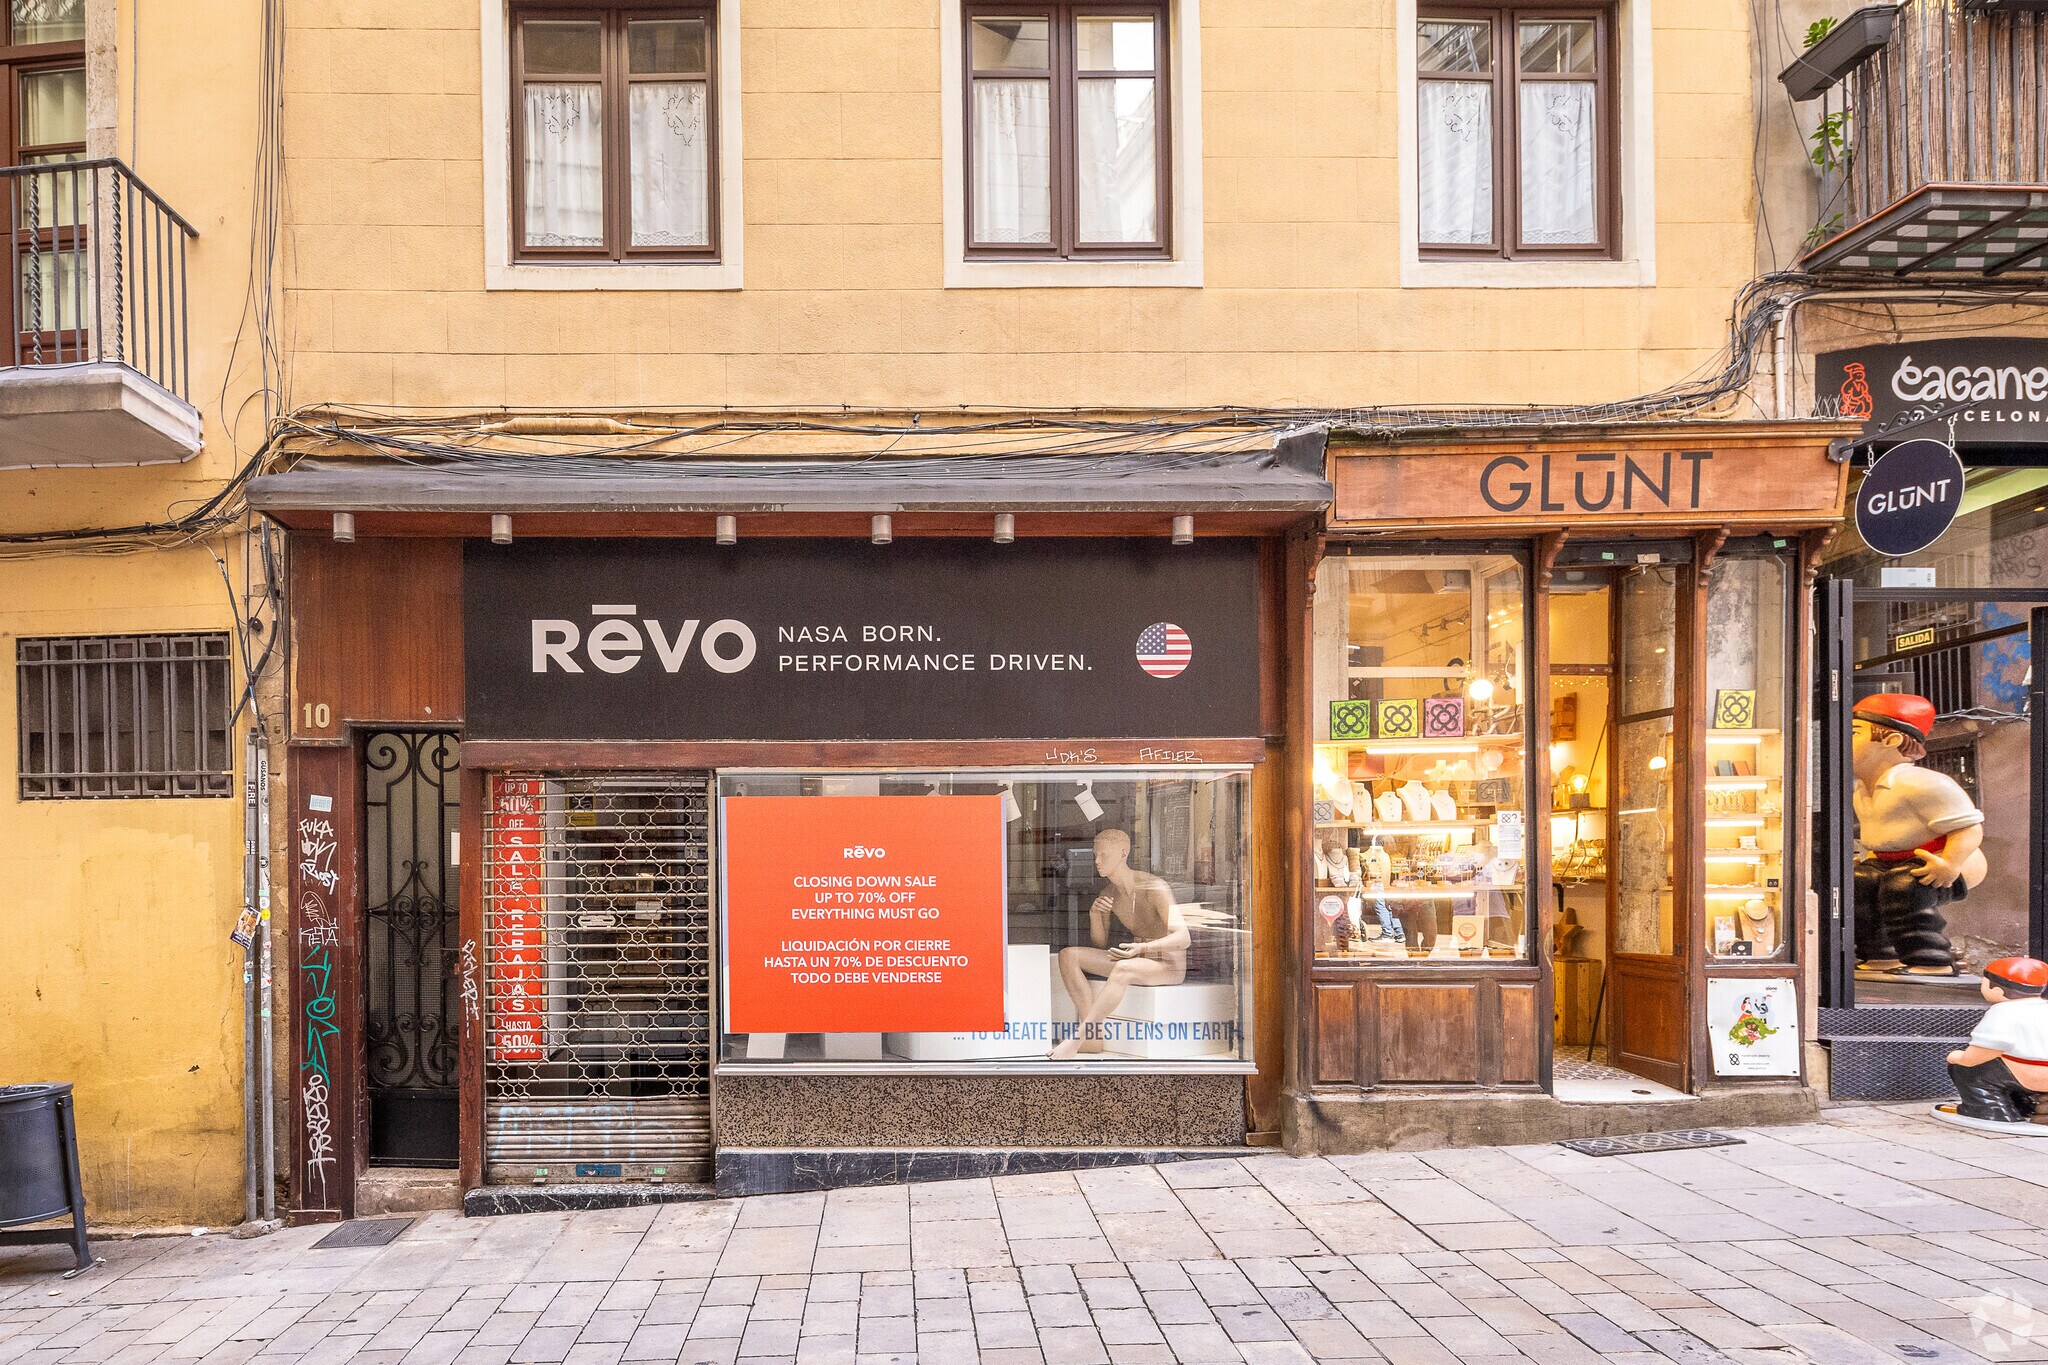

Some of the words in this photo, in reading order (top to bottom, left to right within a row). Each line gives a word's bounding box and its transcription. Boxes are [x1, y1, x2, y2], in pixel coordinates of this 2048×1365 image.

[778, 625, 849, 643] NASA
[862, 625, 942, 643] BORN.
[1899, 633, 1931, 647] SALIDA
[778, 654, 976, 672] PERFORMANCE
[989, 653, 1093, 671] DRIVEN.
[302, 702, 331, 729] 10
[504, 782, 516, 793] UP
[509, 819, 524, 829] OFF
[793, 876, 853, 888] CLOSING
[856, 876, 901, 887] DOWN
[904, 875, 937, 887] SALE
[814, 893, 833, 903] UP
[835, 892, 854, 903] TO
[857, 892, 886, 903] 70%
[889, 892, 916, 903] OFF
[791, 908, 875, 920] EVERYTHING
[878, 908, 915, 919] MUST
[917, 907, 940, 919] GO
[781, 938, 870, 952] LIQUIDACIÓN
[873, 940, 902, 951] POR
[904, 939, 951, 951] CIERRE
[511, 908, 525, 1012] REBAJAS
[764, 956, 808, 968] HASTA
[810, 956, 830, 967] UN
[833, 956, 862, 967] 70%
[865, 956, 884, 967] DE
[886, 955, 969, 967] DESCUENTO
[791, 972, 831, 984] TODO
[834, 972, 870, 983] DEBE
[872, 971, 942, 983] VENDERSE
[504, 1020, 532, 1032] HASTA
[1051, 1022, 1081, 1040] THE
[1085, 1022, 1122, 1040] BEST
[1126, 1022, 1164, 1040] LENS
[1168, 1022, 1188, 1040] ON
[502, 1034, 537, 1054] 50%
